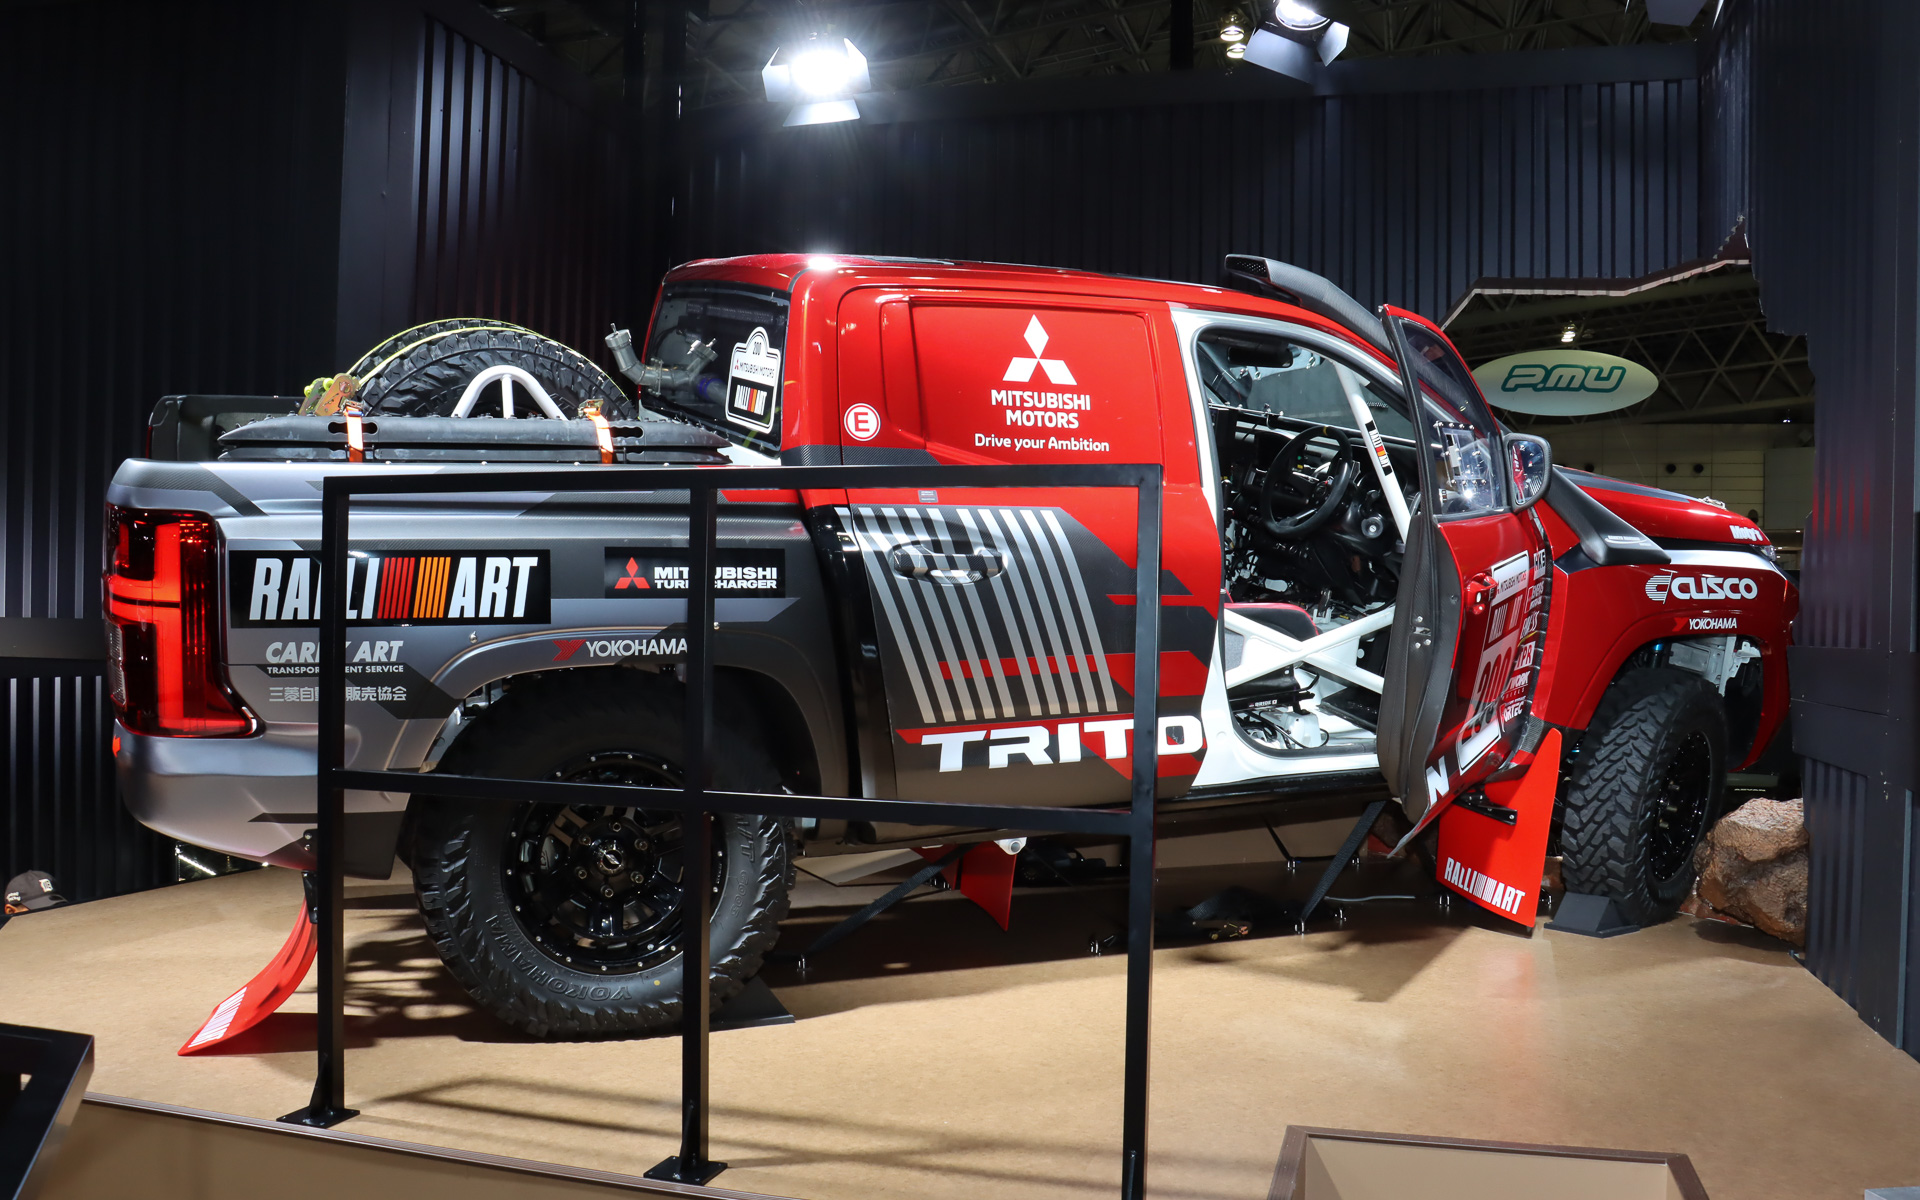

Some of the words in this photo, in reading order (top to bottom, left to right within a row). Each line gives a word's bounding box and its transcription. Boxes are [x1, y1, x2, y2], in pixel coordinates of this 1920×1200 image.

[991, 389, 1091, 410] MITSUBISHI
[1006, 409, 1079, 429] MOTORS
[974, 433, 1011, 449] Drive
[1014, 437, 1046, 451] your
[1048, 436, 1110, 452] Ambition
[249, 556, 539, 621] RALIART
[1671, 577, 1758, 600] CUSCO
[1689, 617, 1738, 630] YOKOHAMA
[352, 640, 404, 663] ART
[365, 665, 404, 673] SERVICE
[1444, 857, 1526, 914] RALLIART
[486, 913, 633, 1002] YOKOHAMA
